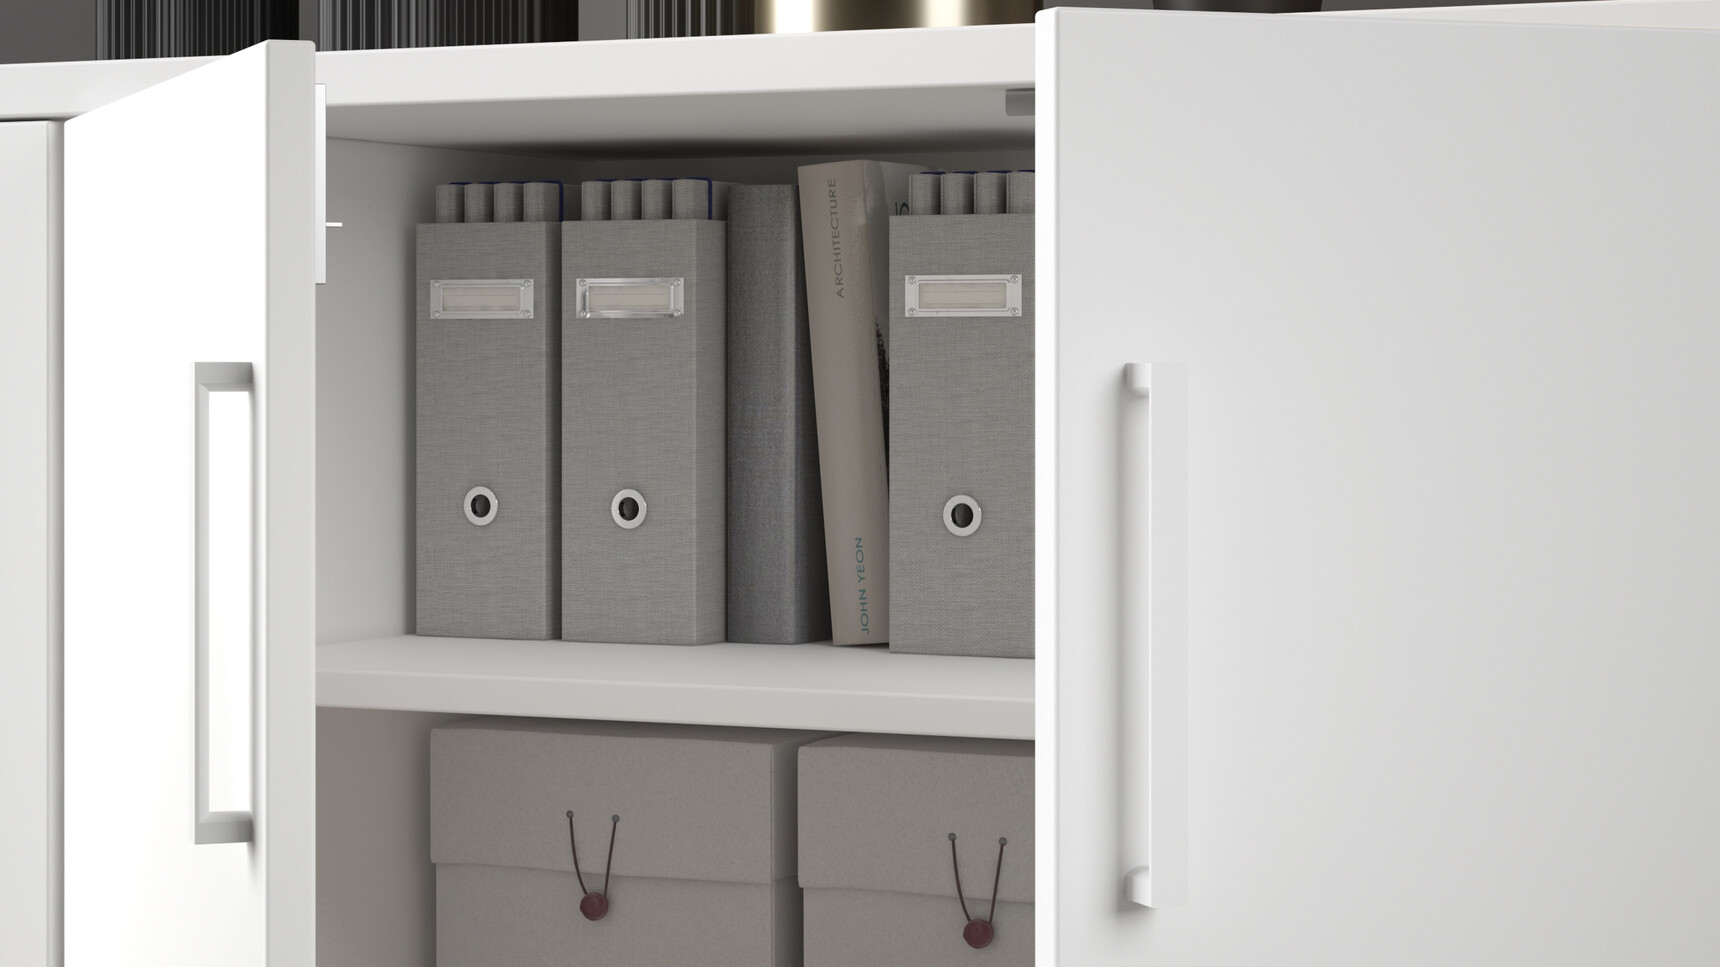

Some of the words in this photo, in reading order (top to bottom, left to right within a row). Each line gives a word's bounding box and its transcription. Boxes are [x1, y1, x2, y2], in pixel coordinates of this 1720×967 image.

[827, 178, 845, 298] ARCHITECTURE
[854, 537, 866, 584] YEON
[858, 589, 870, 635] JOHN
